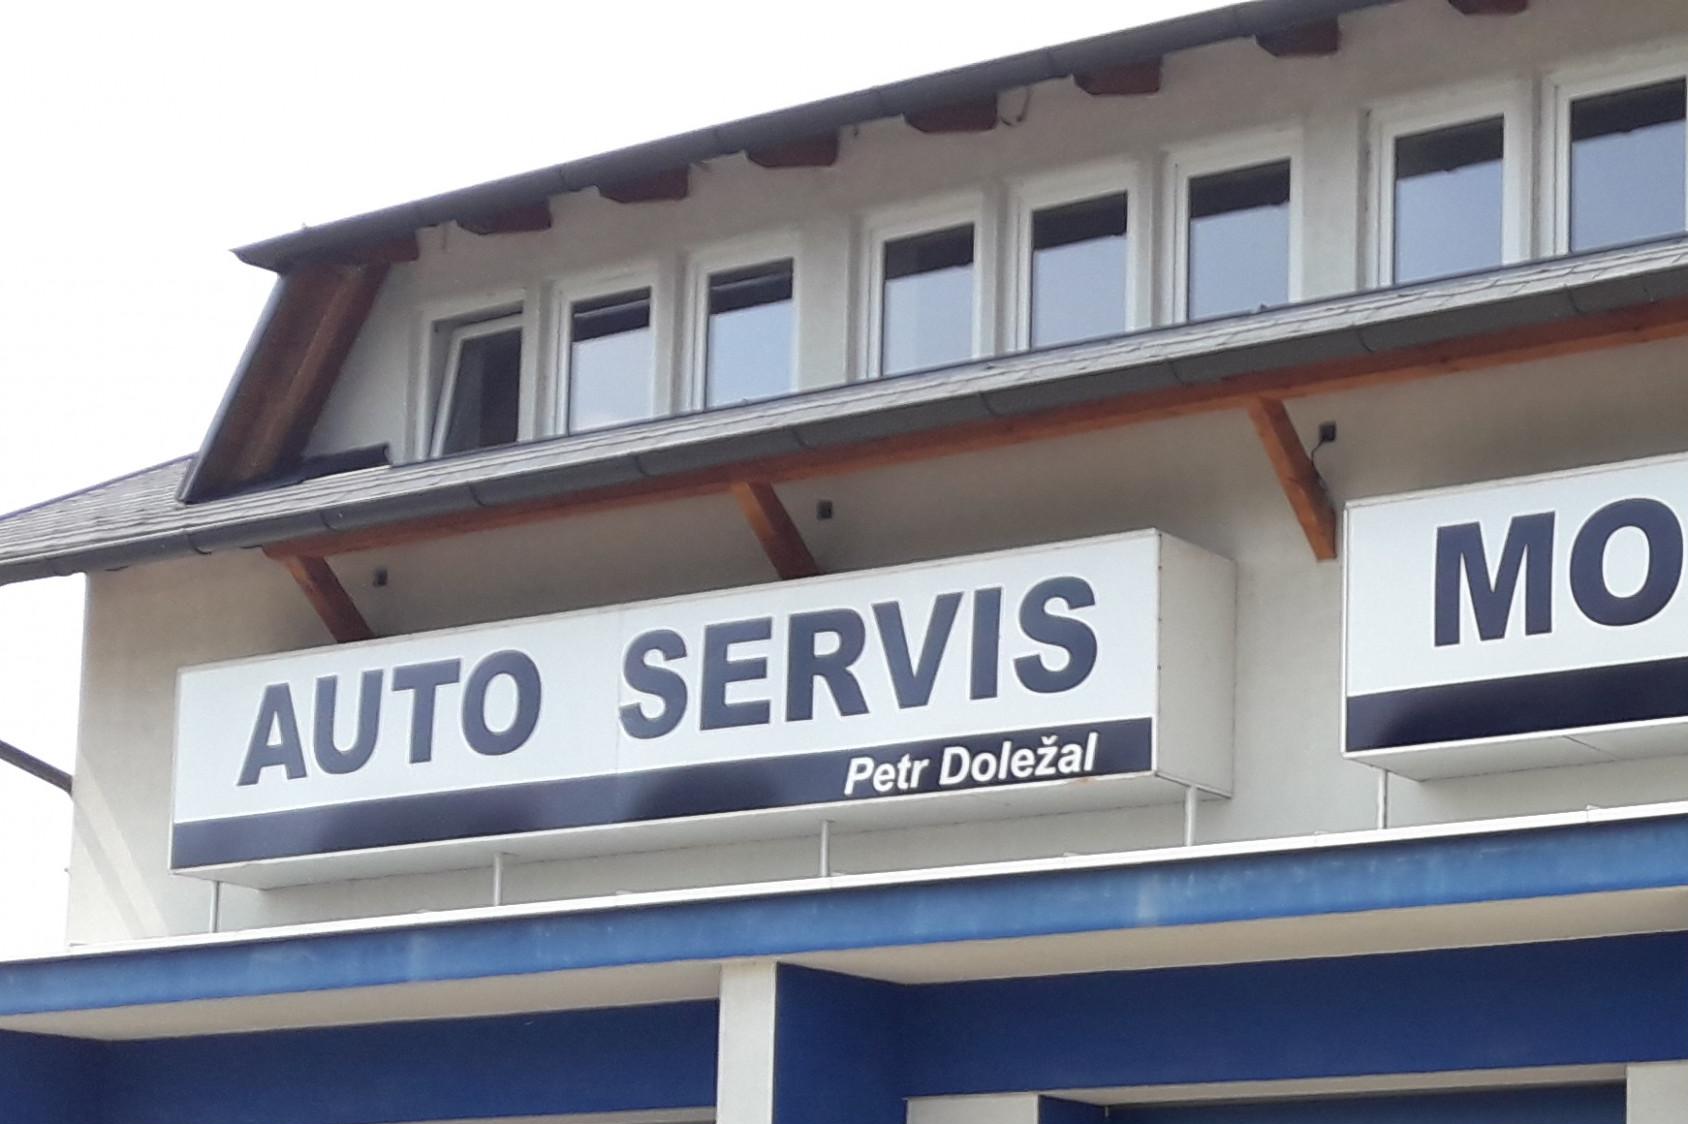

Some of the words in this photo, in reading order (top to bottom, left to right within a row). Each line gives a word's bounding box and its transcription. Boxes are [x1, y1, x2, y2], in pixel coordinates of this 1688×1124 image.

[237, 649, 543, 787] AUTO
[617, 575, 1097, 739] SERVIS
[844, 753, 929, 796] Petr
[938, 732, 1098, 788] Doležal
